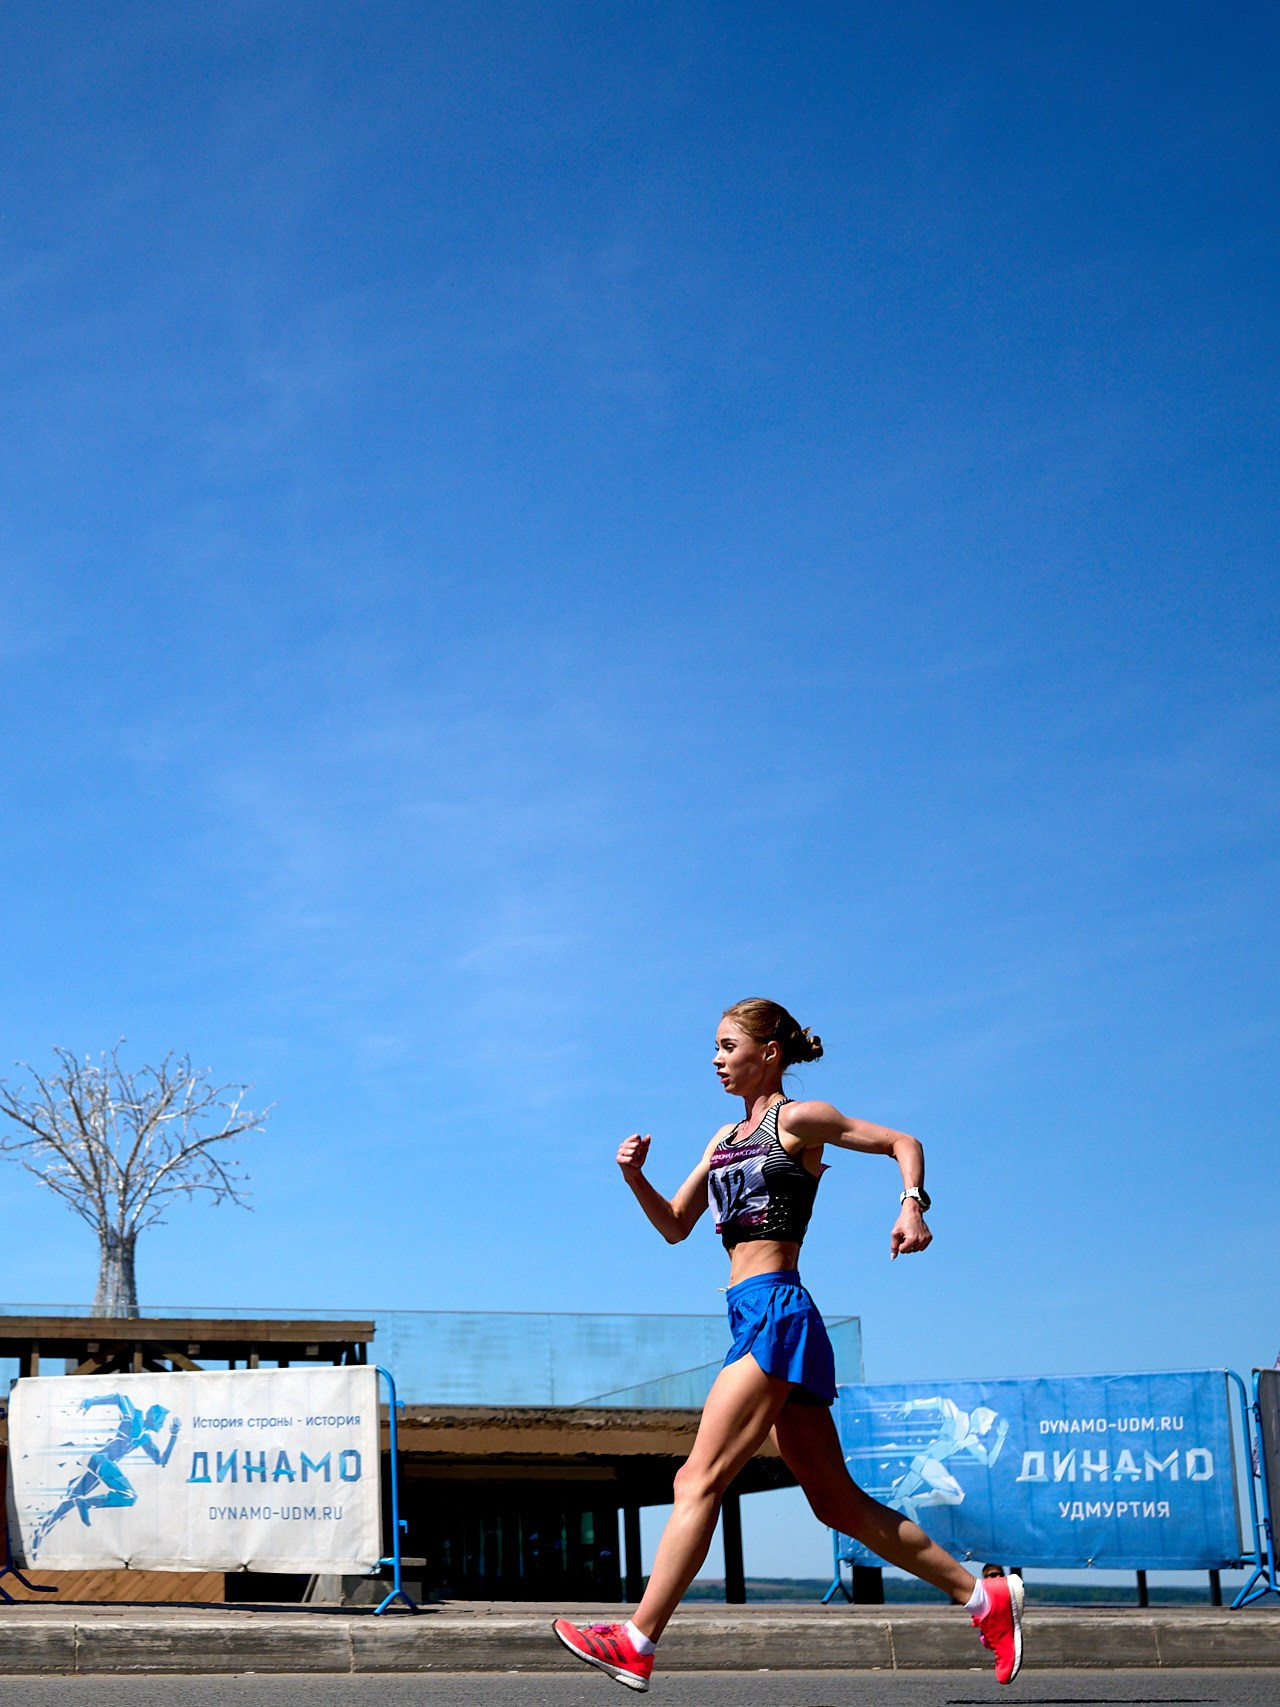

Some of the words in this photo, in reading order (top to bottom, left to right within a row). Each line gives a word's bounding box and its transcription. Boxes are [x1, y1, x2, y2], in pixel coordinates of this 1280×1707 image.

[192, 1415, 243, 1431] История
[247, 1417, 293, 1431] страны
[305, 1415, 361, 1430] история
[1040, 1415, 1184, 1434] DYNAMO-UDM.RU
[185, 1448, 362, 1484] ДИНАМО
[1015, 1447, 1214, 1483] ДИНАМО
[209, 1506, 343, 1522] DYNAMO-UDM.RU
[1058, 1501, 1170, 1521] УДМУРТИЯ
